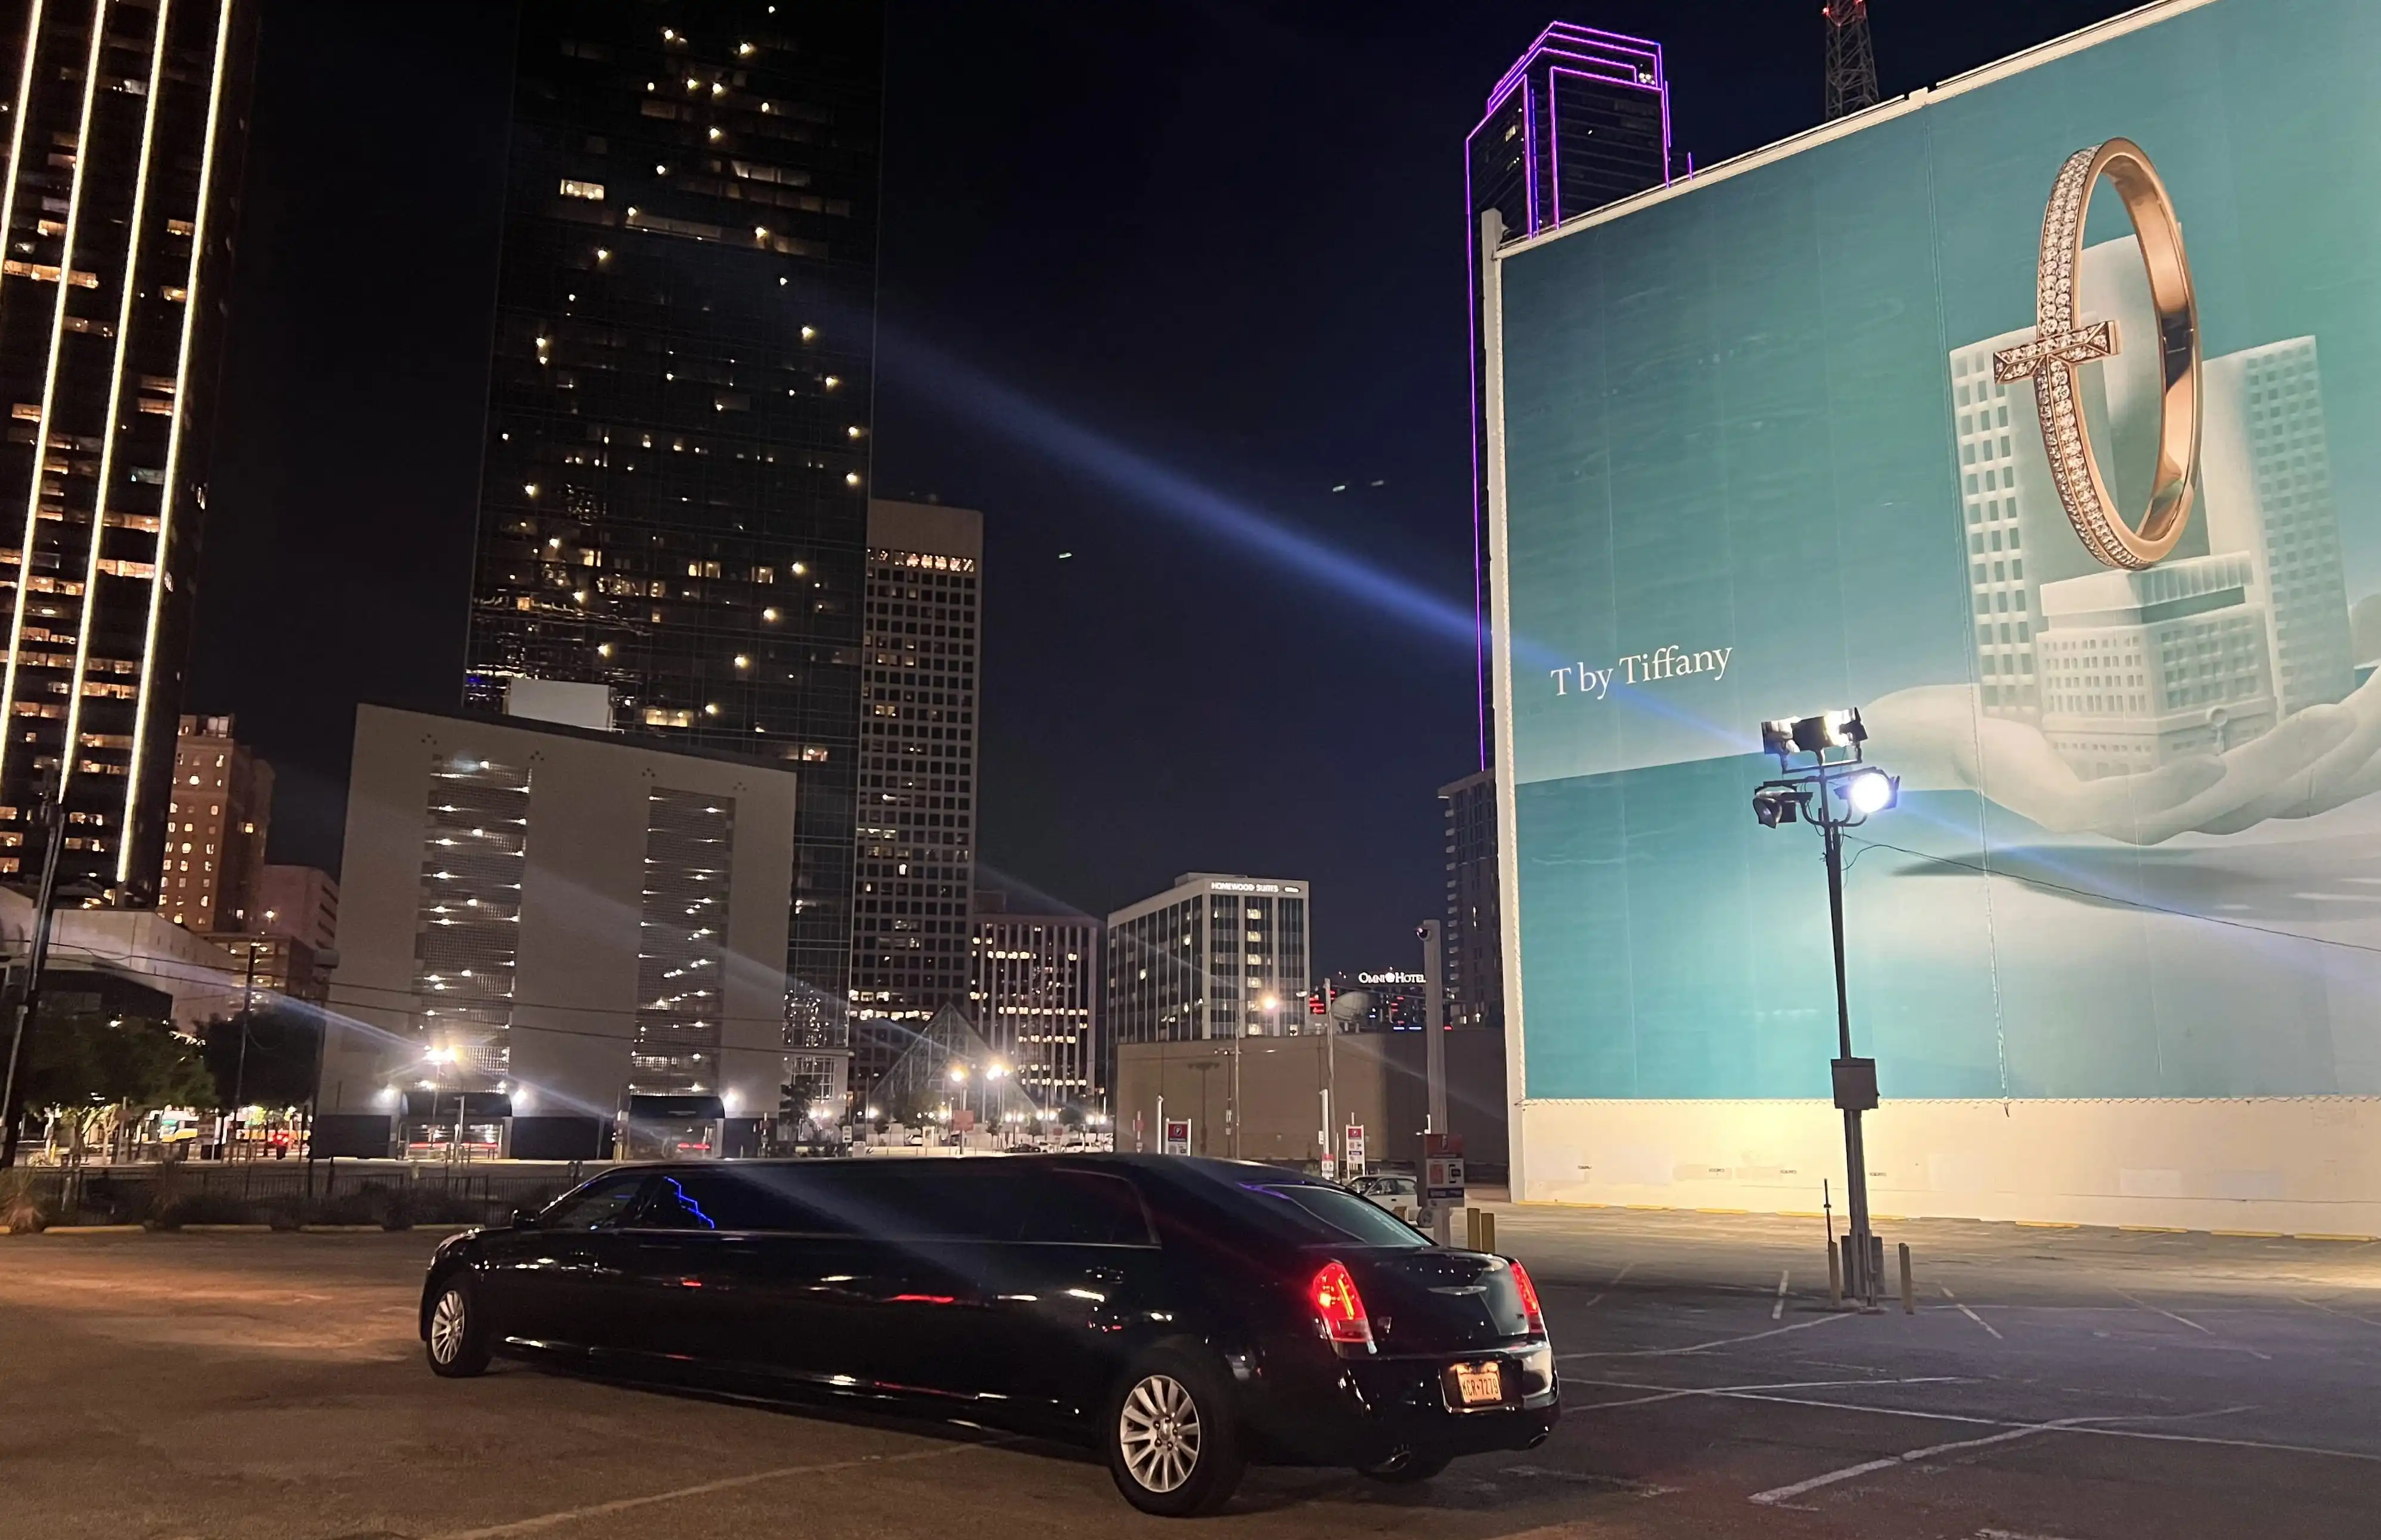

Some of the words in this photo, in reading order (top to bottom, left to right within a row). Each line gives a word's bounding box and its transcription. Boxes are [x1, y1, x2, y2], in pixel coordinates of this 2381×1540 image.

[1550, 667, 1572, 696] T
[1577, 662, 1613, 700] by
[1619, 645, 1733, 684] Tiffany
[1210, 881, 1255, 892] HOMEWOOD
[1256, 883, 1279, 893] SUITES
